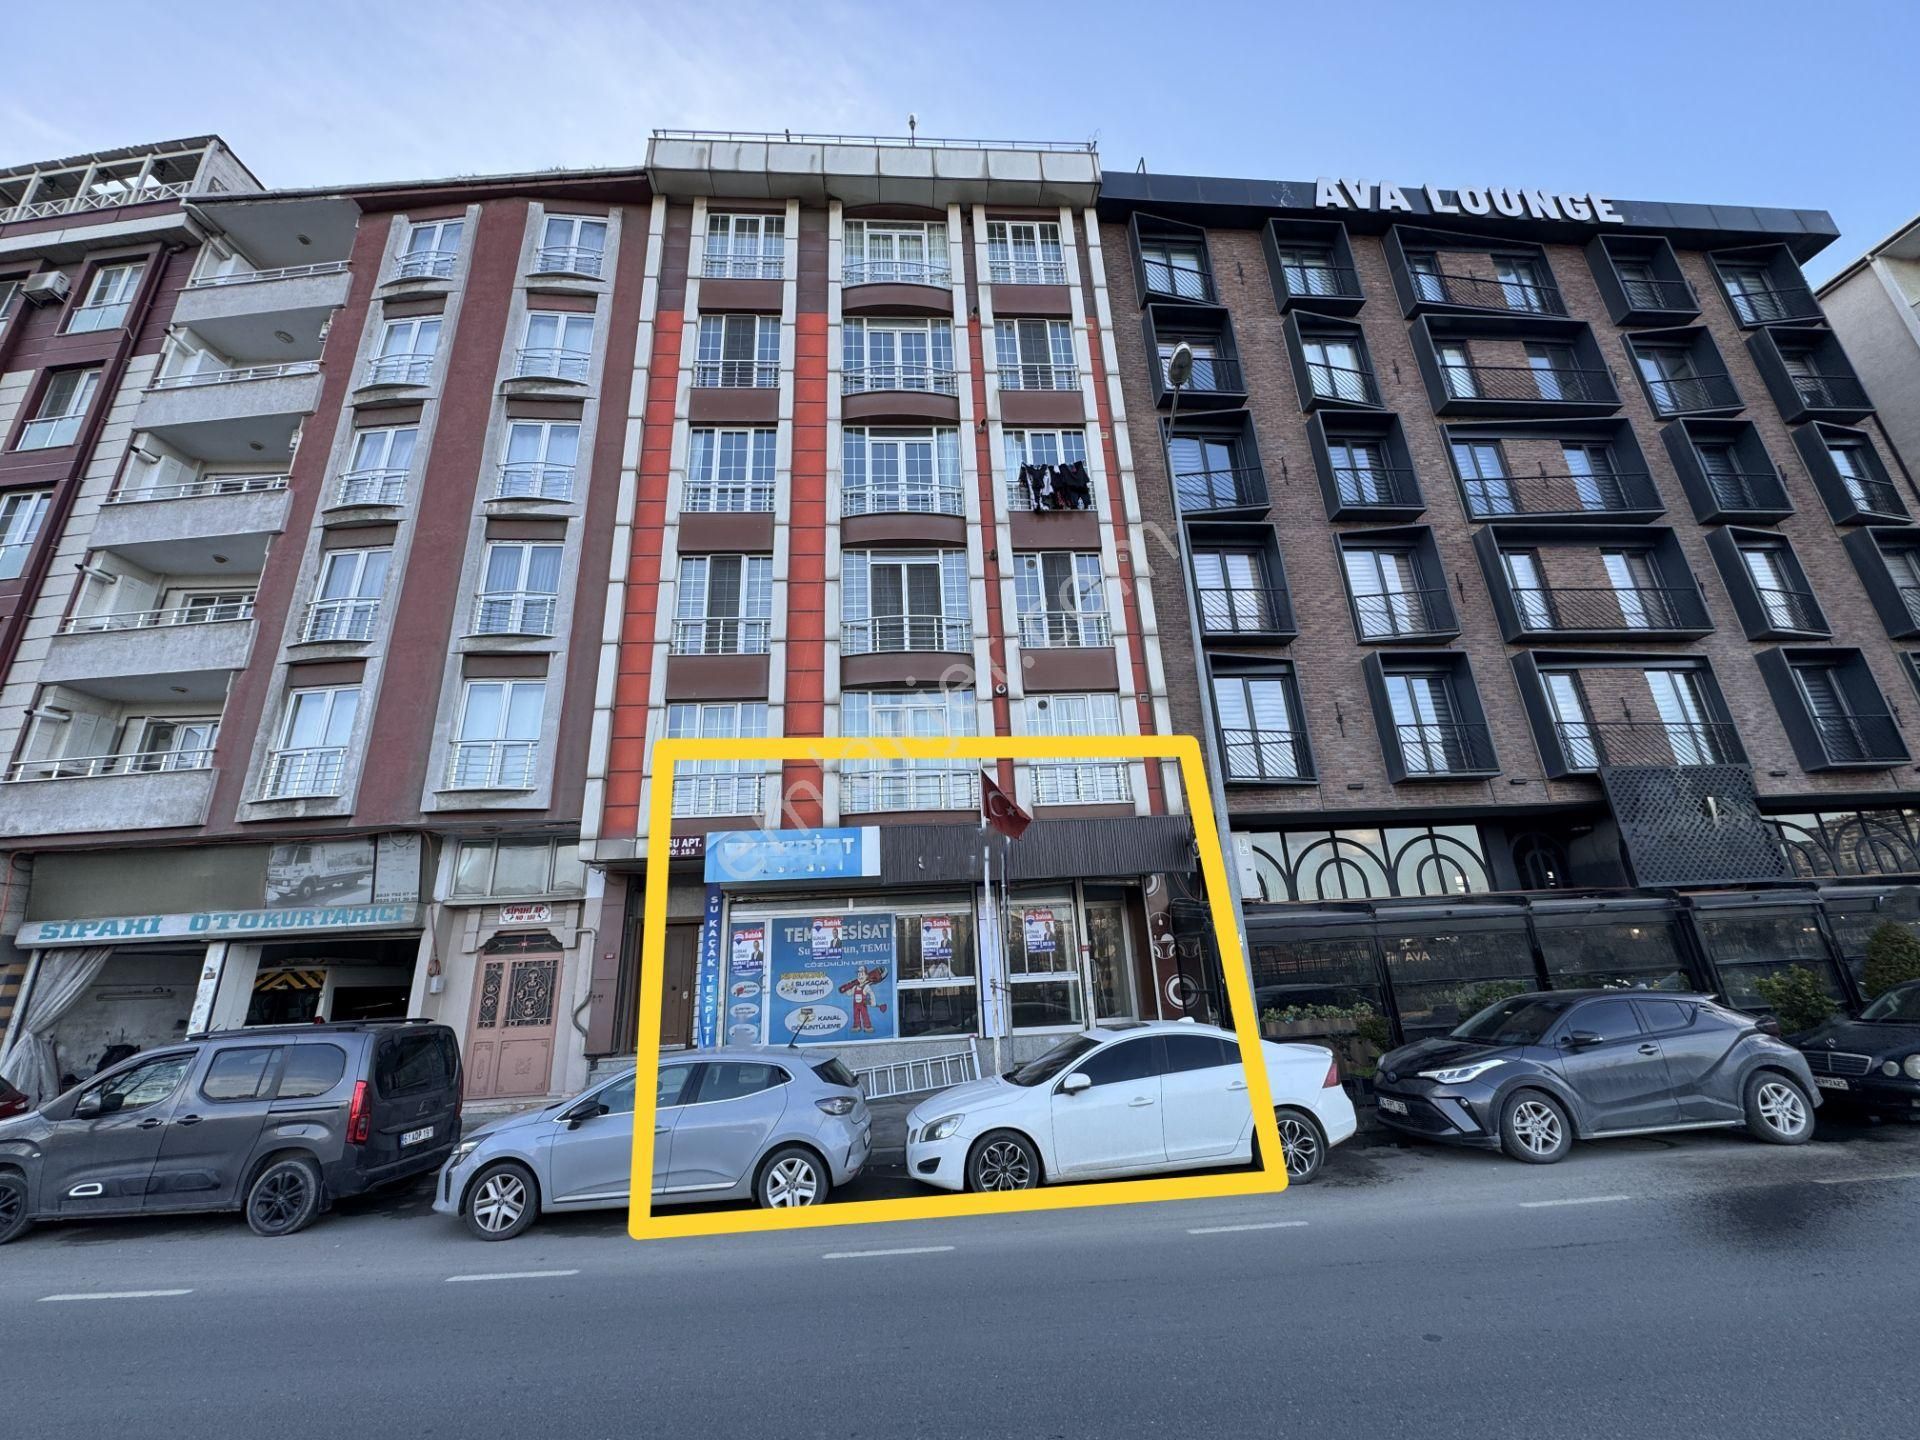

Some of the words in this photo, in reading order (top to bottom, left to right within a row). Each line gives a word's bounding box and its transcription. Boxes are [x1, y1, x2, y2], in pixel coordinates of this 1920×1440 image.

[1316, 177, 1412, 211] AVA
[1423, 183, 1624, 223] LOUNGE
[681, 837, 702, 848] APT.
[709, 895, 719, 913] SU
[784, 927, 813, 943] TEM
[840, 920, 890, 941] ESİSAT
[860, 943, 890, 953] TEMU
[1405, 951, 1431, 962] AVA
